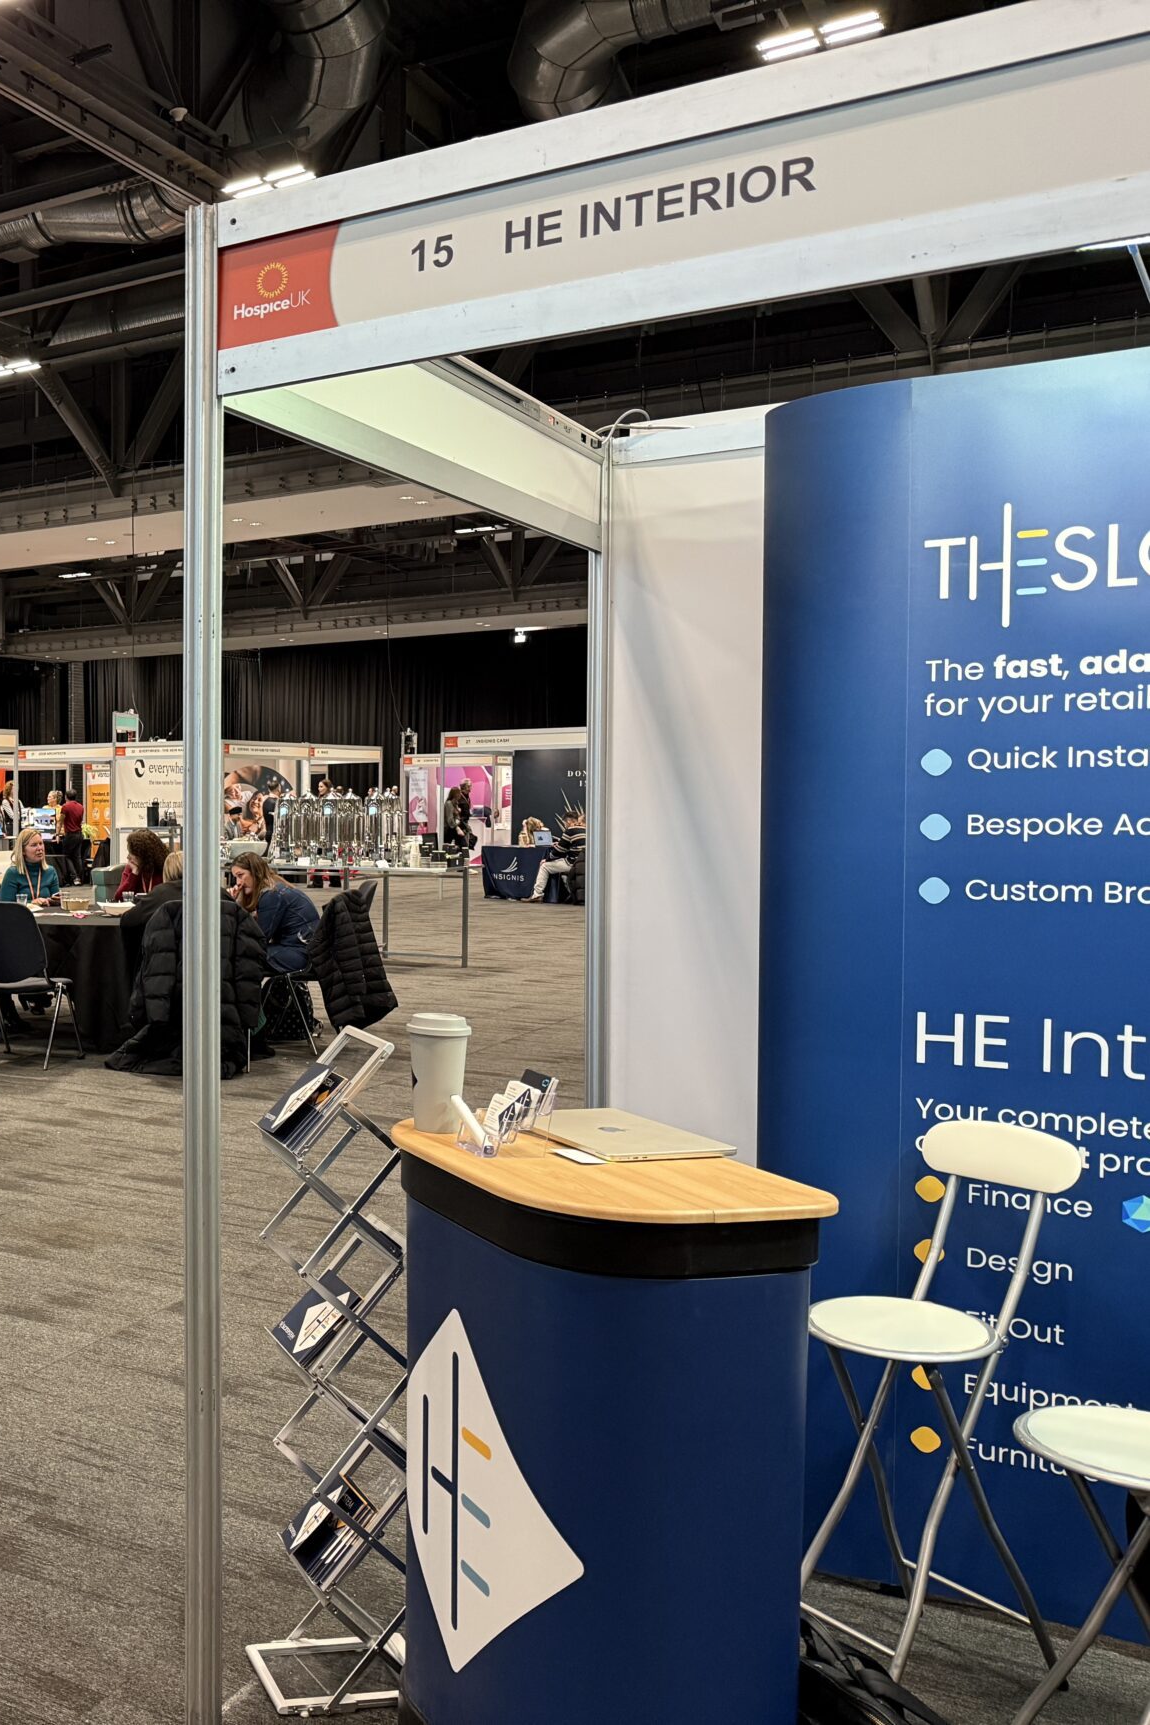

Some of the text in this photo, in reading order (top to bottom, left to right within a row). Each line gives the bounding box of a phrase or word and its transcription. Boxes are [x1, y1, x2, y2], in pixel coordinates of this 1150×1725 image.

[410, 155, 816, 272] 15 HE INTERIOR
[925, 658, 984, 682] The
[993, 653, 1070, 681] fast,
[924, 693, 969, 717] for
[977, 693, 1054, 722] your
[967, 746, 1058, 773] Quick
[967, 812, 1103, 842] Bespoke
[965, 879, 1093, 902] Custom
[915, 1011, 1010, 1069] HE
[915, 1097, 988, 1121] Your
[966, 1247, 1073, 1285] Desgn
[1008, 1318, 1065, 1346] Out
